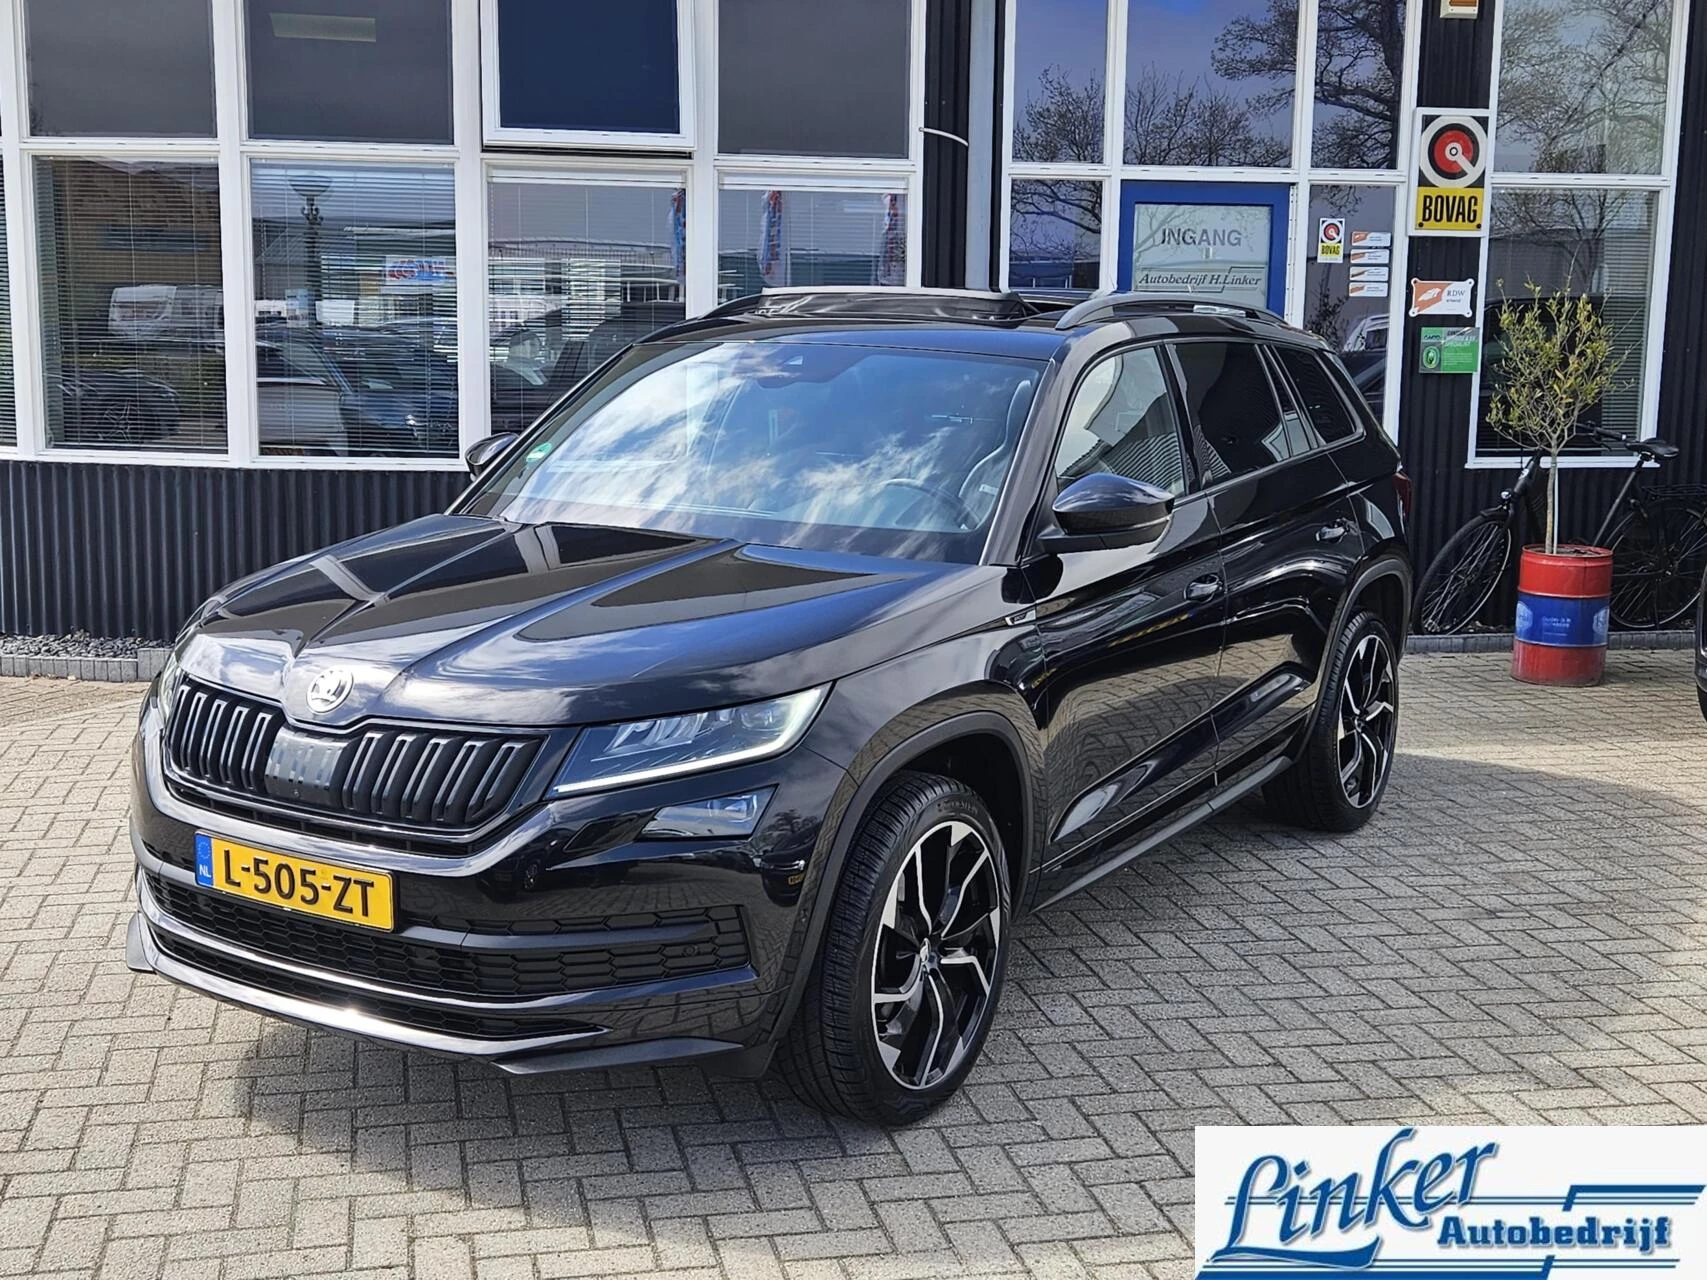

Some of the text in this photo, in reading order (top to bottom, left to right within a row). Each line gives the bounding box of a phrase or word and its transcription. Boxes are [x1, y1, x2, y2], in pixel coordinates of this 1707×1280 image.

[1422, 195, 1478, 223] BOVAG
[1161, 228, 1242, 246] INGANG
[1139, 273, 1209, 286] Autobedrijf
[1446, 289, 1466, 297] RDW
[199, 864, 212, 878] NL
[224, 849, 375, 917] L-505-ZT
